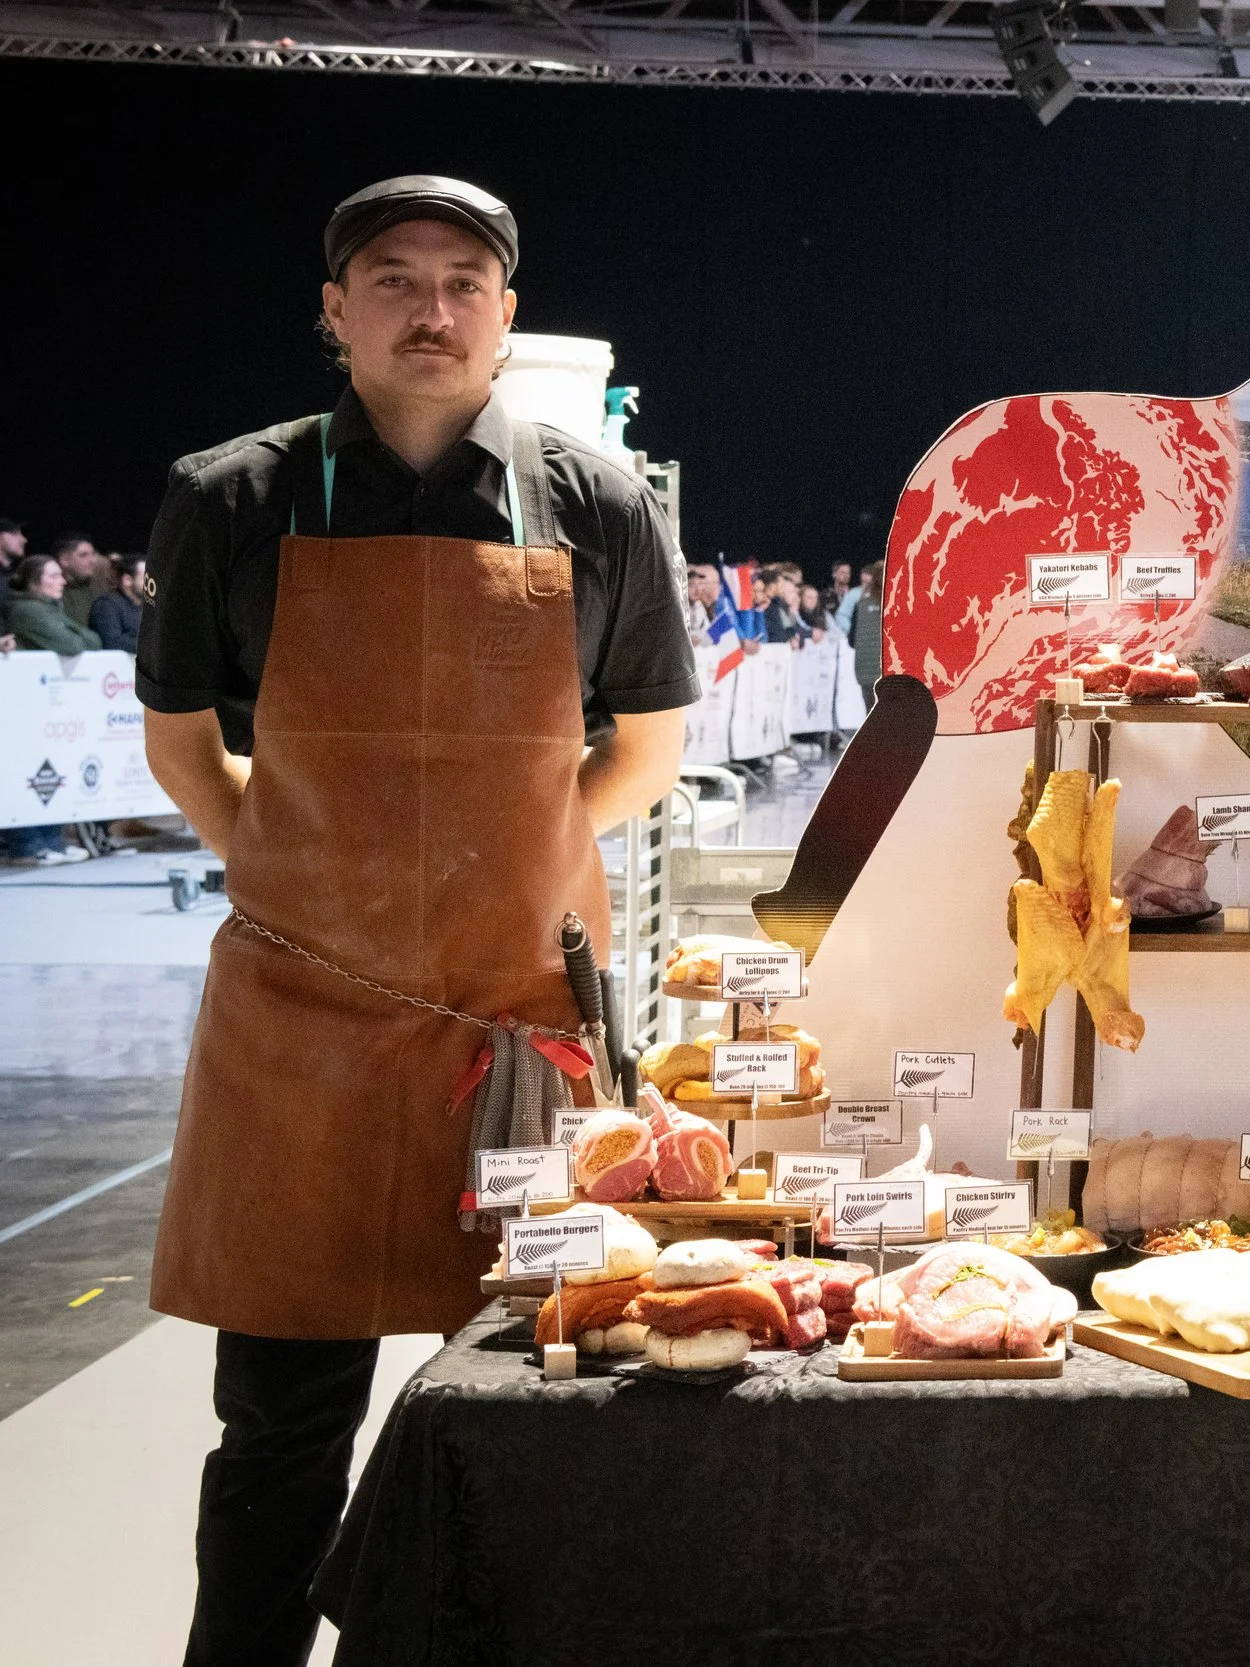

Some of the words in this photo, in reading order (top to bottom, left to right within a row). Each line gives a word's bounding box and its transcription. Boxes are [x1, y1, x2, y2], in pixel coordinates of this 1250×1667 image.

[1039, 565, 1069, 573] Yakatori
[1070, 564, 1098, 572] Kebabs
[1153, 566, 1181, 574] Truffles
[1212, 806, 1232, 814] Lamb
[736, 957, 767, 965] Chicken
[768, 956, 788, 964] Drum
[745, 968, 780, 976] Lollipops
[726, 1054, 755, 1062] Stuffed
[901, 1054, 919, 1064] Pork
[925, 1055, 956, 1065] Cutlets
[747, 1064, 767, 1072] Rack
[838, 1105, 864, 1113] Double
[865, 1105, 890, 1113] Breast
[561, 1117, 587, 1126] Chick
[852, 1115, 876, 1123] Crown
[1023, 1115, 1043, 1126] Pork
[1049, 1116, 1069, 1126] Rack
[487, 1159, 510, 1168] Mini
[517, 1154, 546, 1165] Roast
[793, 1165, 811, 1173] Beef
[813, 1166, 839, 1175] Tri-Tip
[846, 1193, 865, 1202] Pork
[867, 1192, 884, 1201] Loin
[886, 1192, 913, 1201] Swirls
[956, 1193, 989, 1202] Chicken
[990, 1192, 1016, 1200] Stirfry
[514, 1227, 561, 1239] Portabello
[563, 1225, 599, 1235] Burgers
